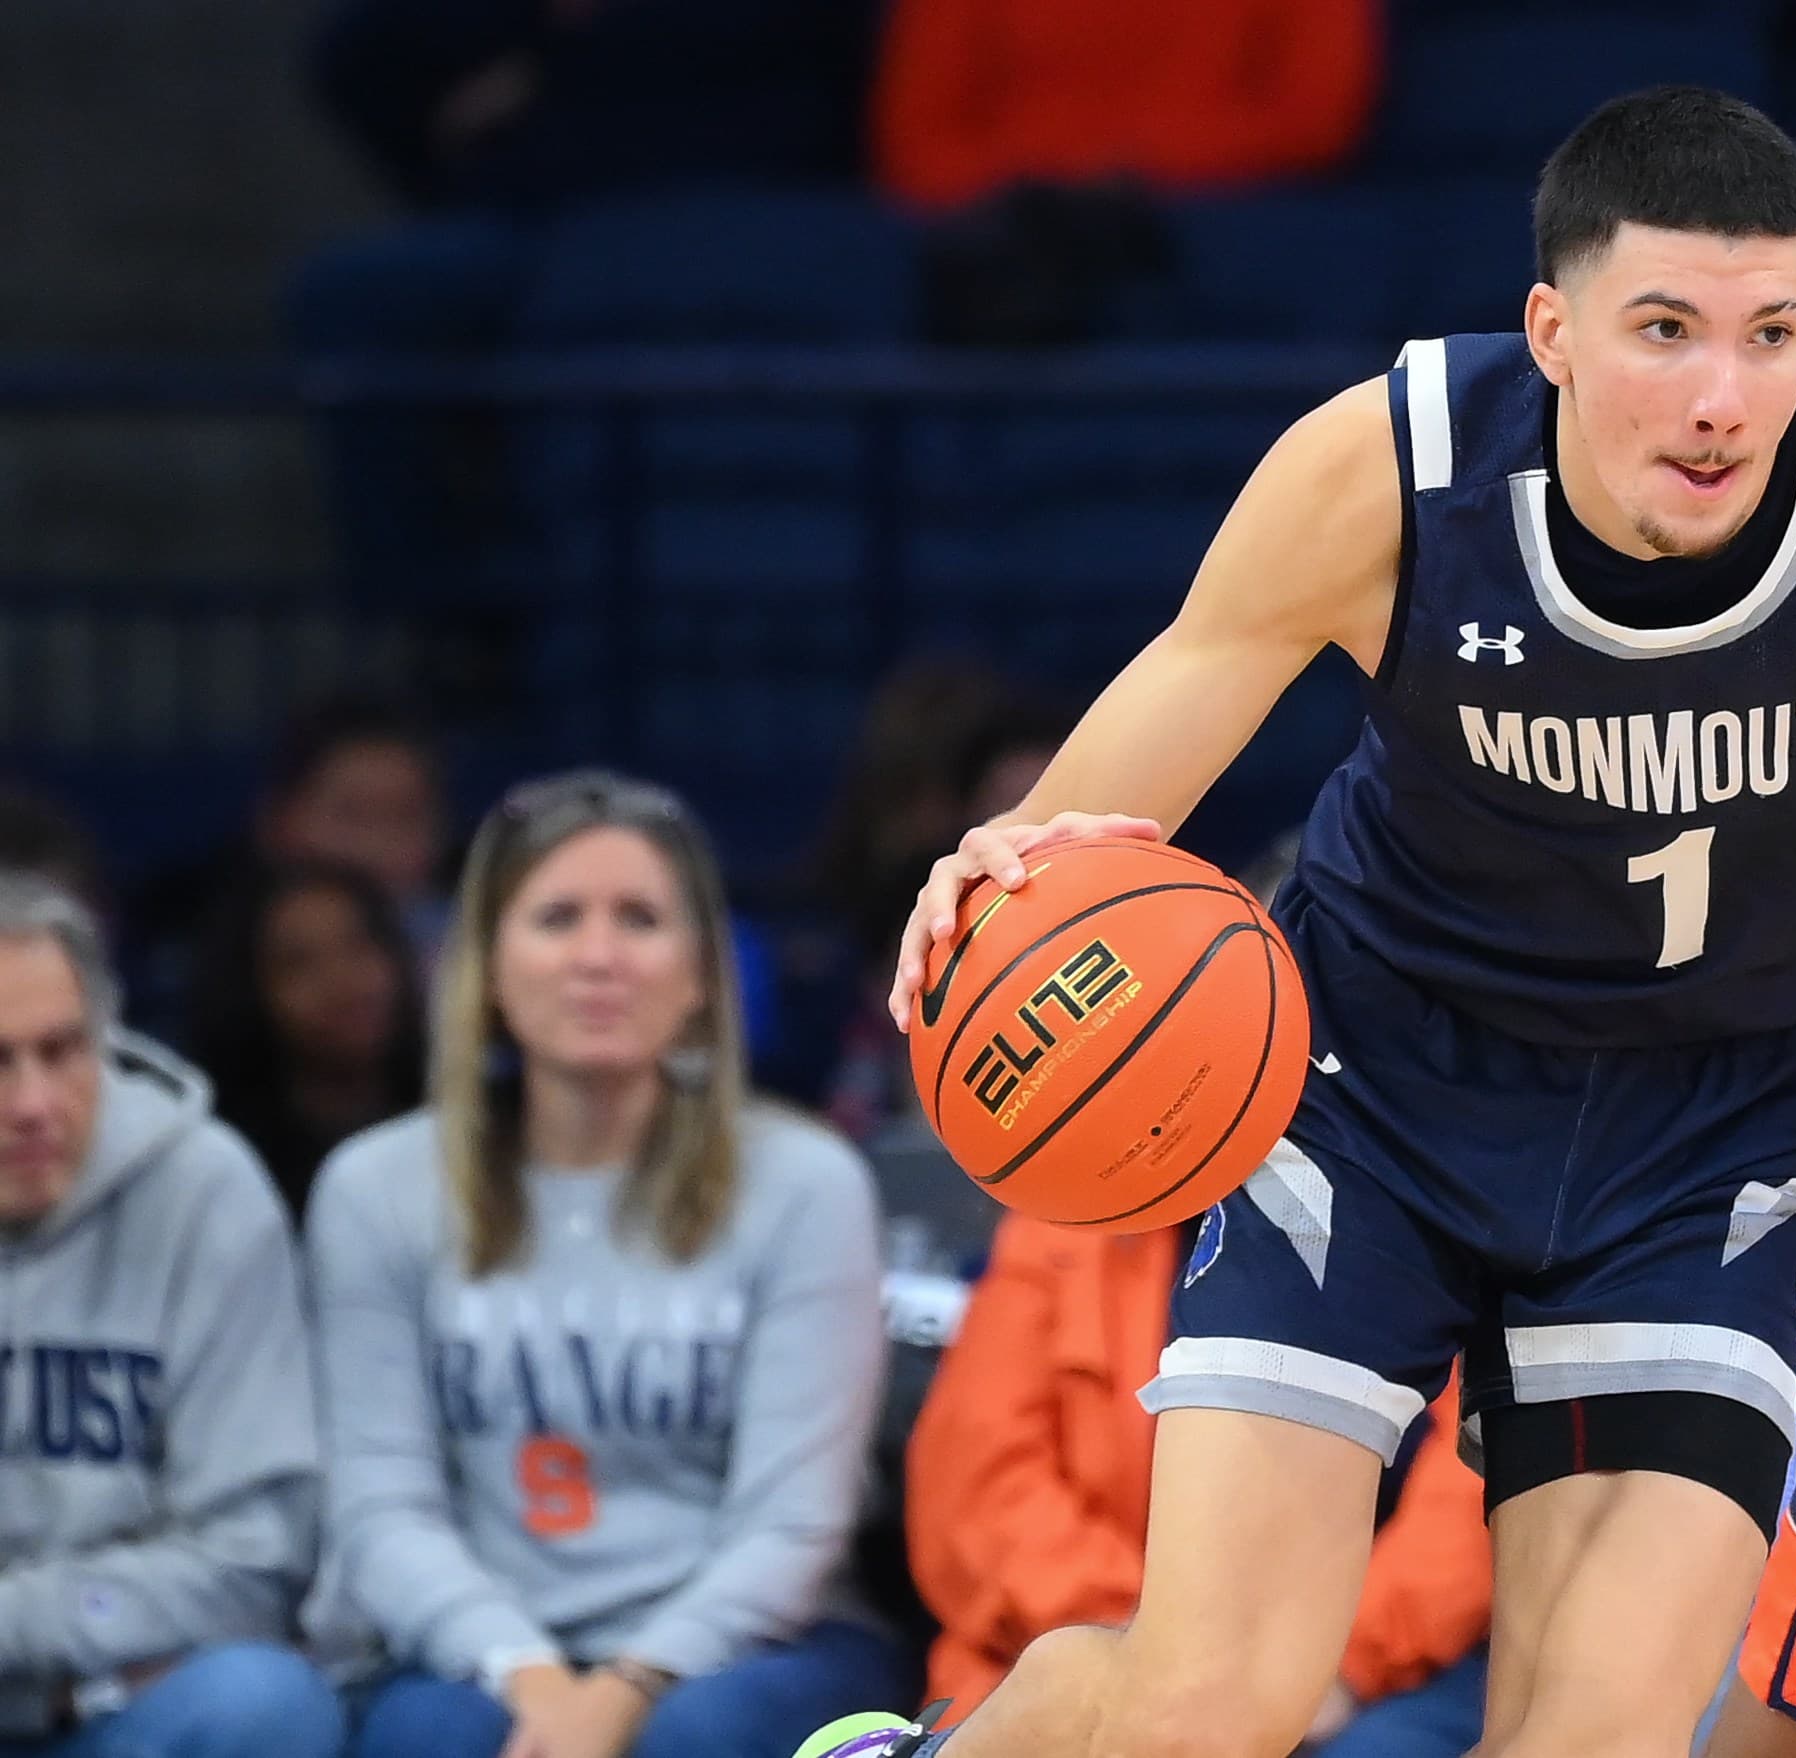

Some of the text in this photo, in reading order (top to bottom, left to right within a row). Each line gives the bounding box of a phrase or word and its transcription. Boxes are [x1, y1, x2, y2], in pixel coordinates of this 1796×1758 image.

[1627, 825, 1717, 969] 1
[961, 936, 1135, 1118] ELITE
[999, 979, 1144, 1132] CHAMPIONSHIP
[430, 1330, 740, 1436] RANGE
[516, 1430, 597, 1542] S
